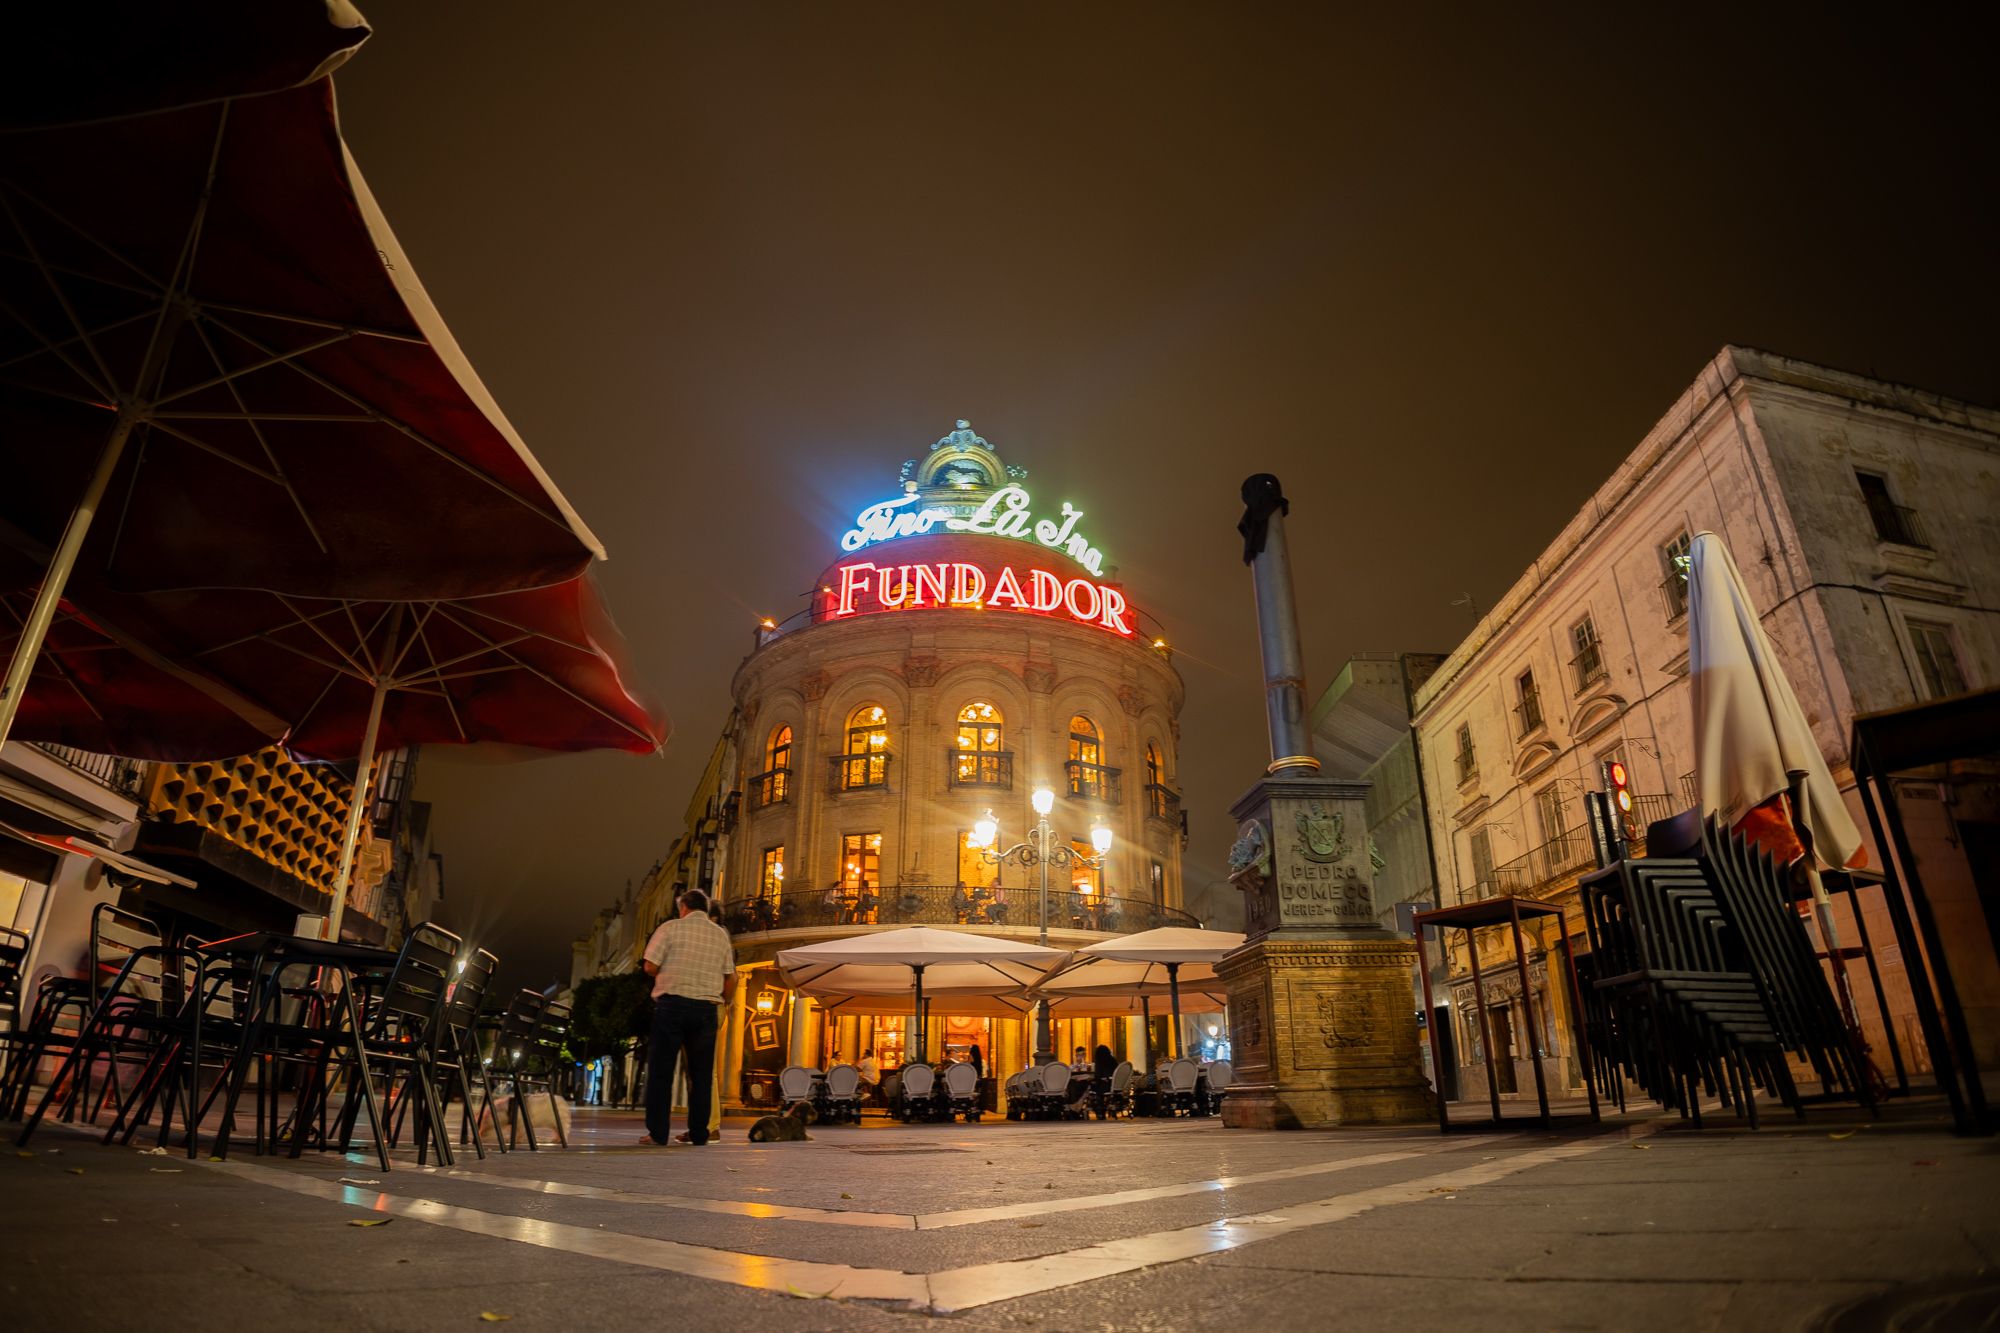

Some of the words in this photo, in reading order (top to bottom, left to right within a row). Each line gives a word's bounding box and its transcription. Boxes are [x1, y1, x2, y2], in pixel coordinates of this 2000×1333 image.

[841, 493, 950, 551] Fino
[946, 487, 1032, 537] La
[836, 562, 1132, 635] FUNDADOR
[1280, 883, 1371, 902] DOMECQ
[1291, 864, 1358, 880] PEDRO
